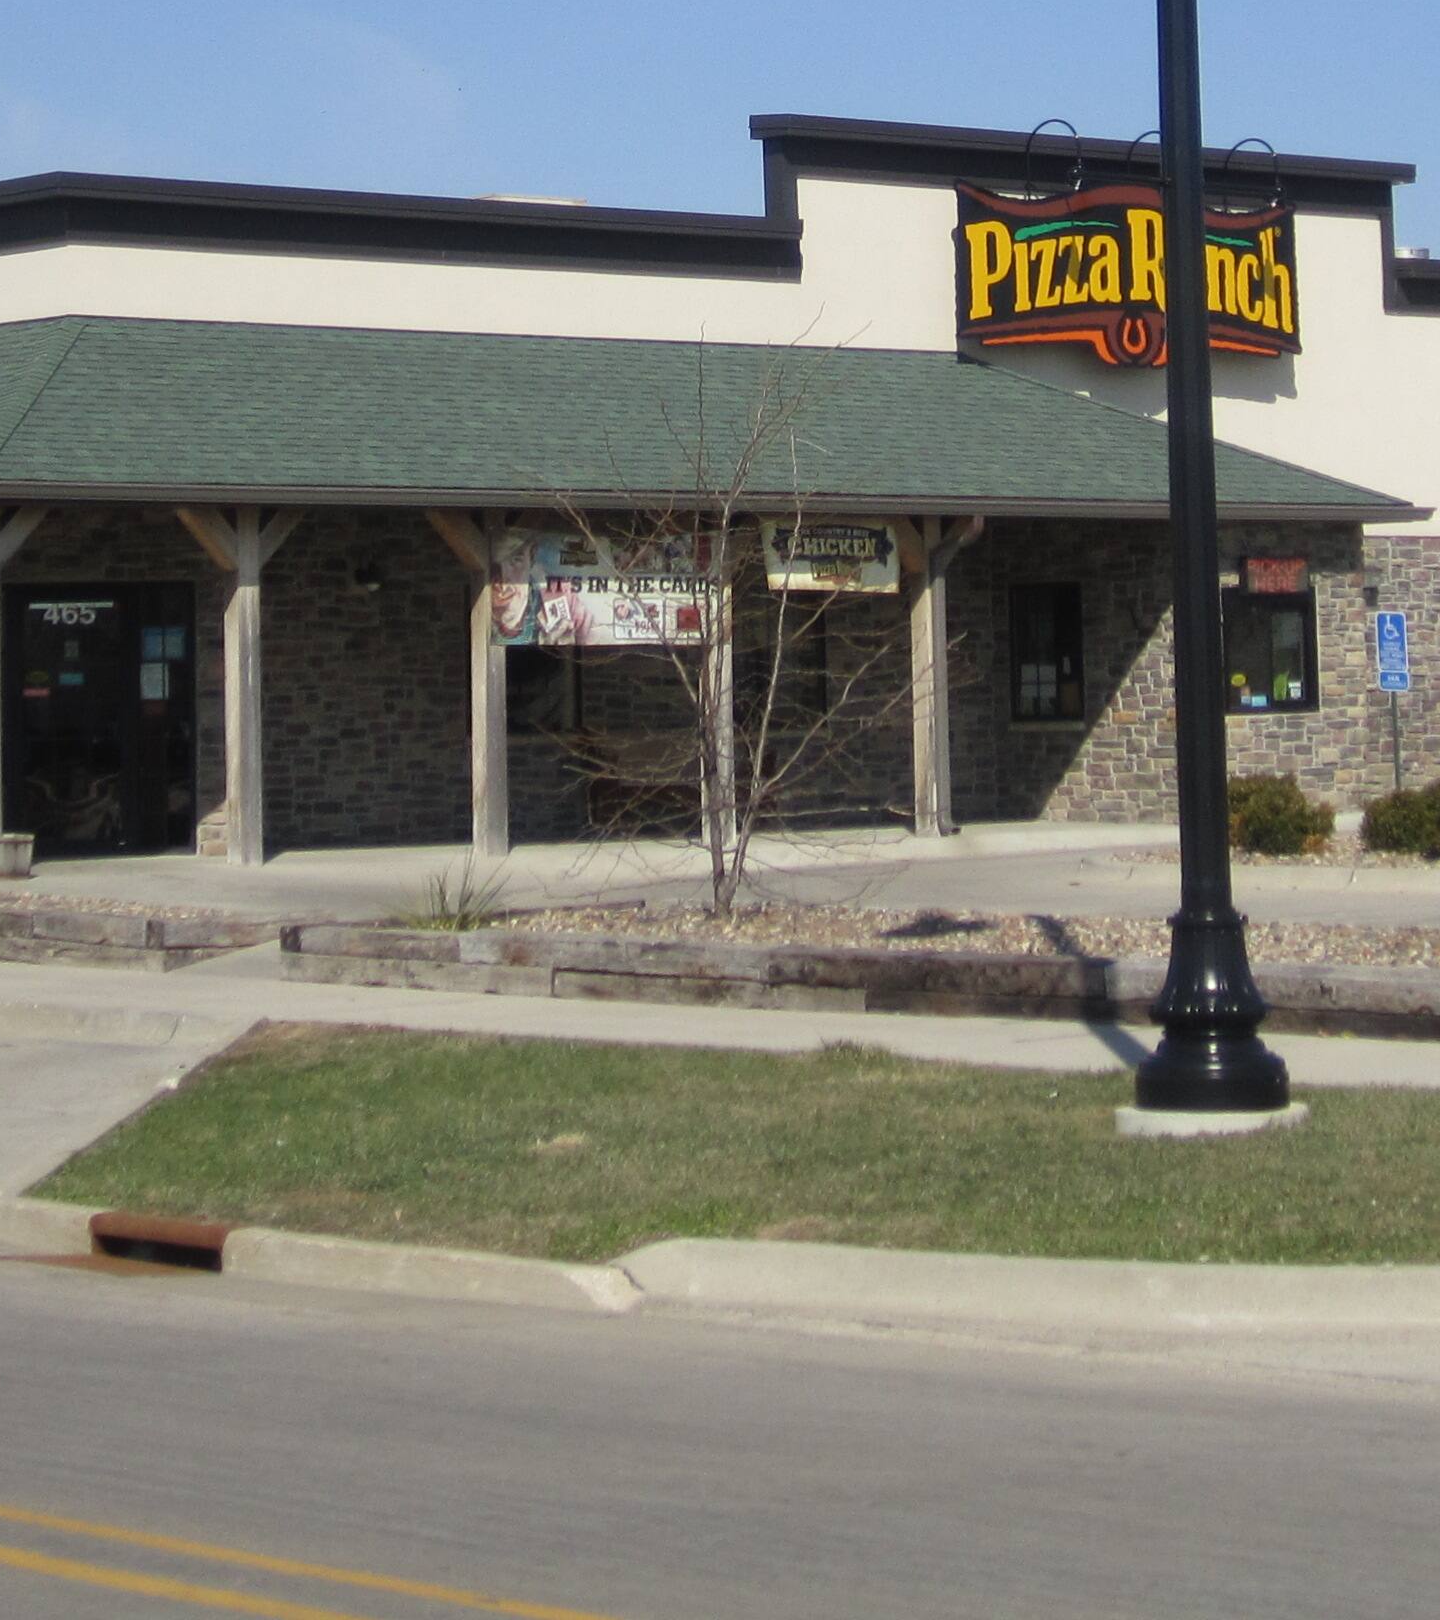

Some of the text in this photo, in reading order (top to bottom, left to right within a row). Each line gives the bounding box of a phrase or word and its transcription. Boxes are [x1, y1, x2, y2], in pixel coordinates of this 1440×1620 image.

[965, 208, 1294, 334] Pizza Rnch
[787, 537, 876, 557] CHICKEN
[545, 576, 582, 593] IT'S
[587, 577, 609, 593] IN
[613, 576, 656, 593] THE
[43, 604, 96, 625] 465
